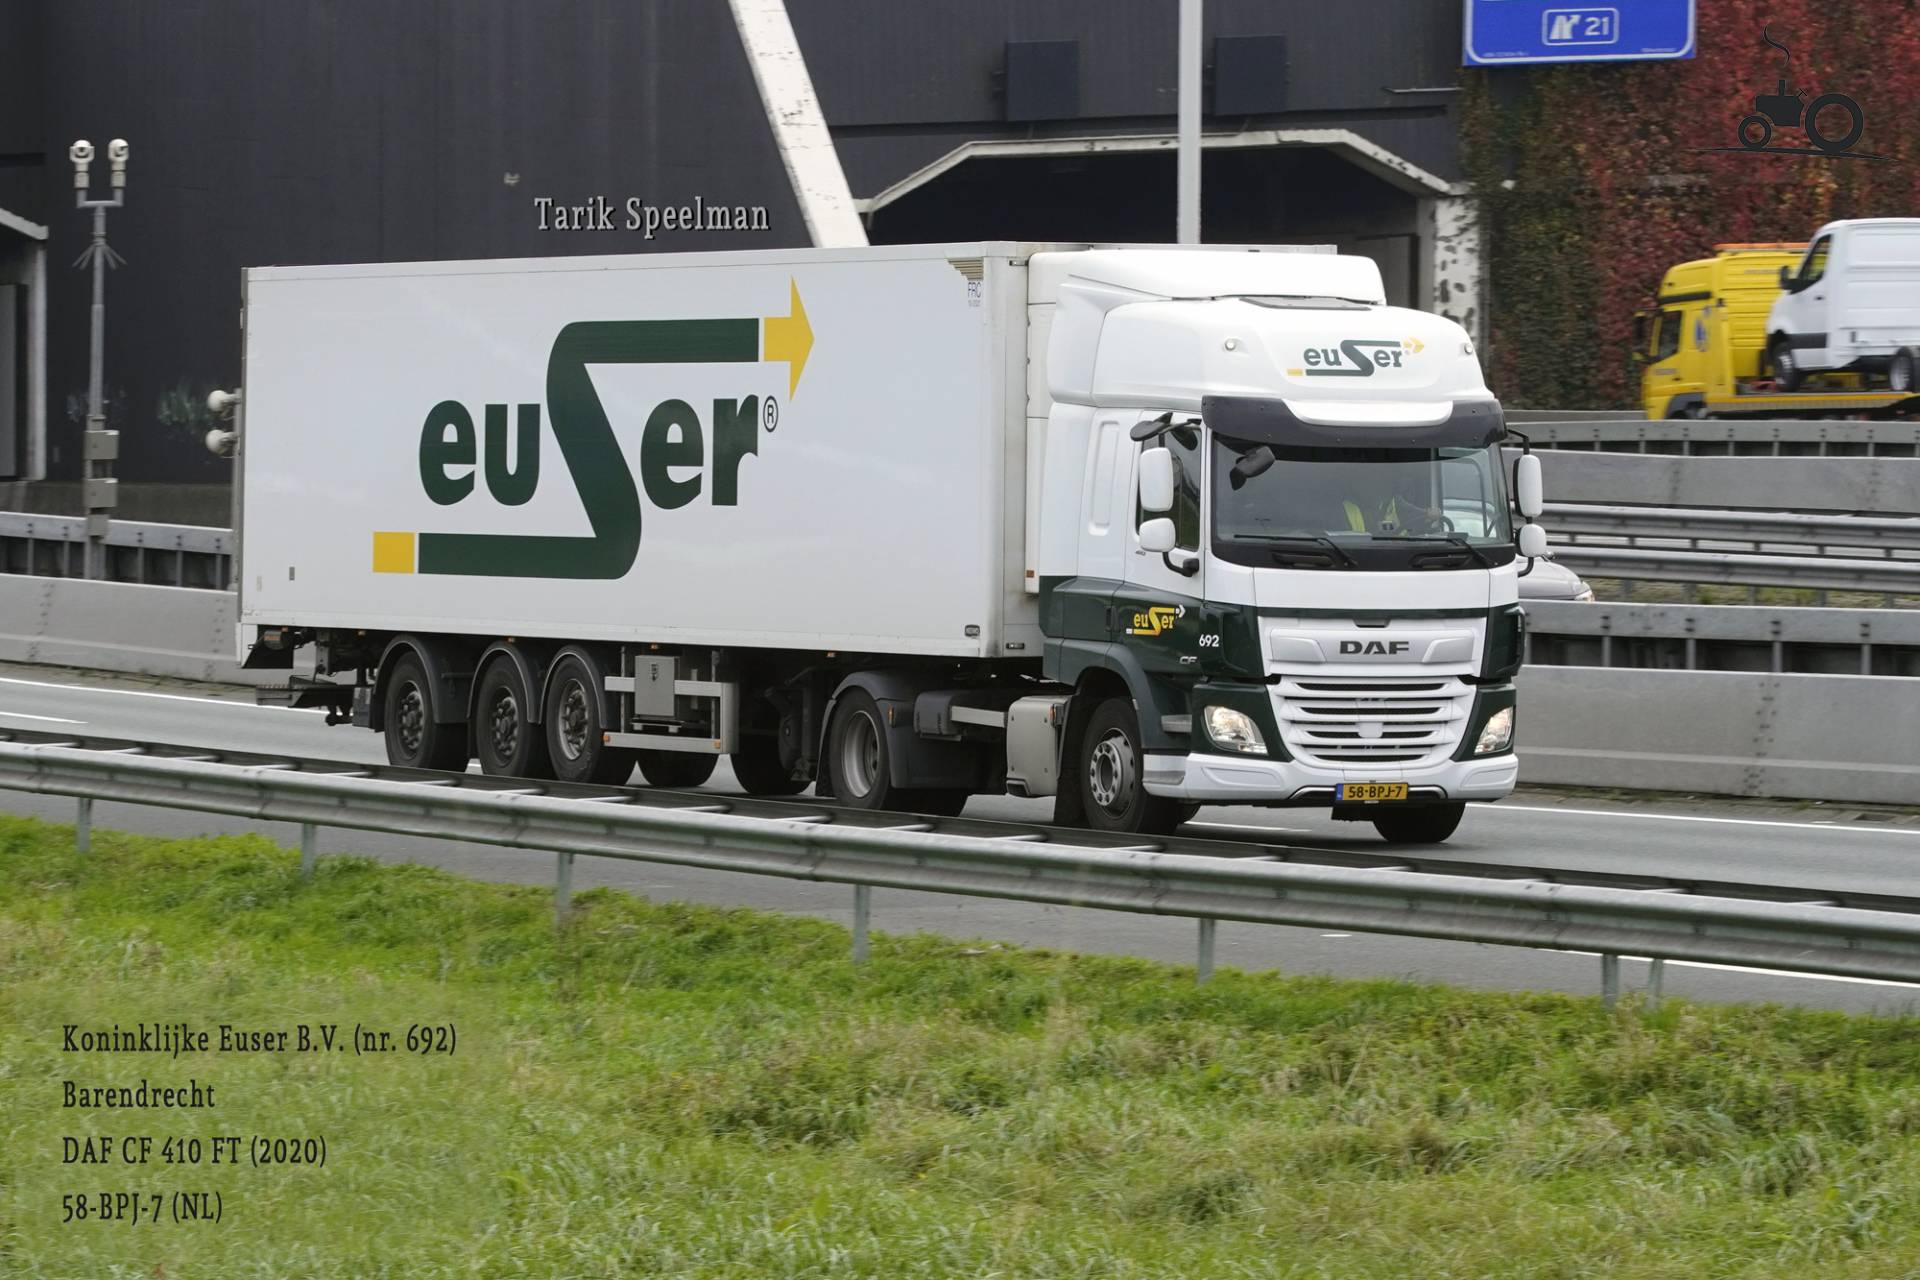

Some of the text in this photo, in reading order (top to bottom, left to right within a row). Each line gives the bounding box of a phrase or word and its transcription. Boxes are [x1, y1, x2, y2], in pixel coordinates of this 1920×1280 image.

[1584, 17, 1609, 36] 21
[1198, 633, 1220, 648] 692
[1339, 640, 1410, 655] DAF
[1348, 785, 1404, 799] 58-BPJ-7
